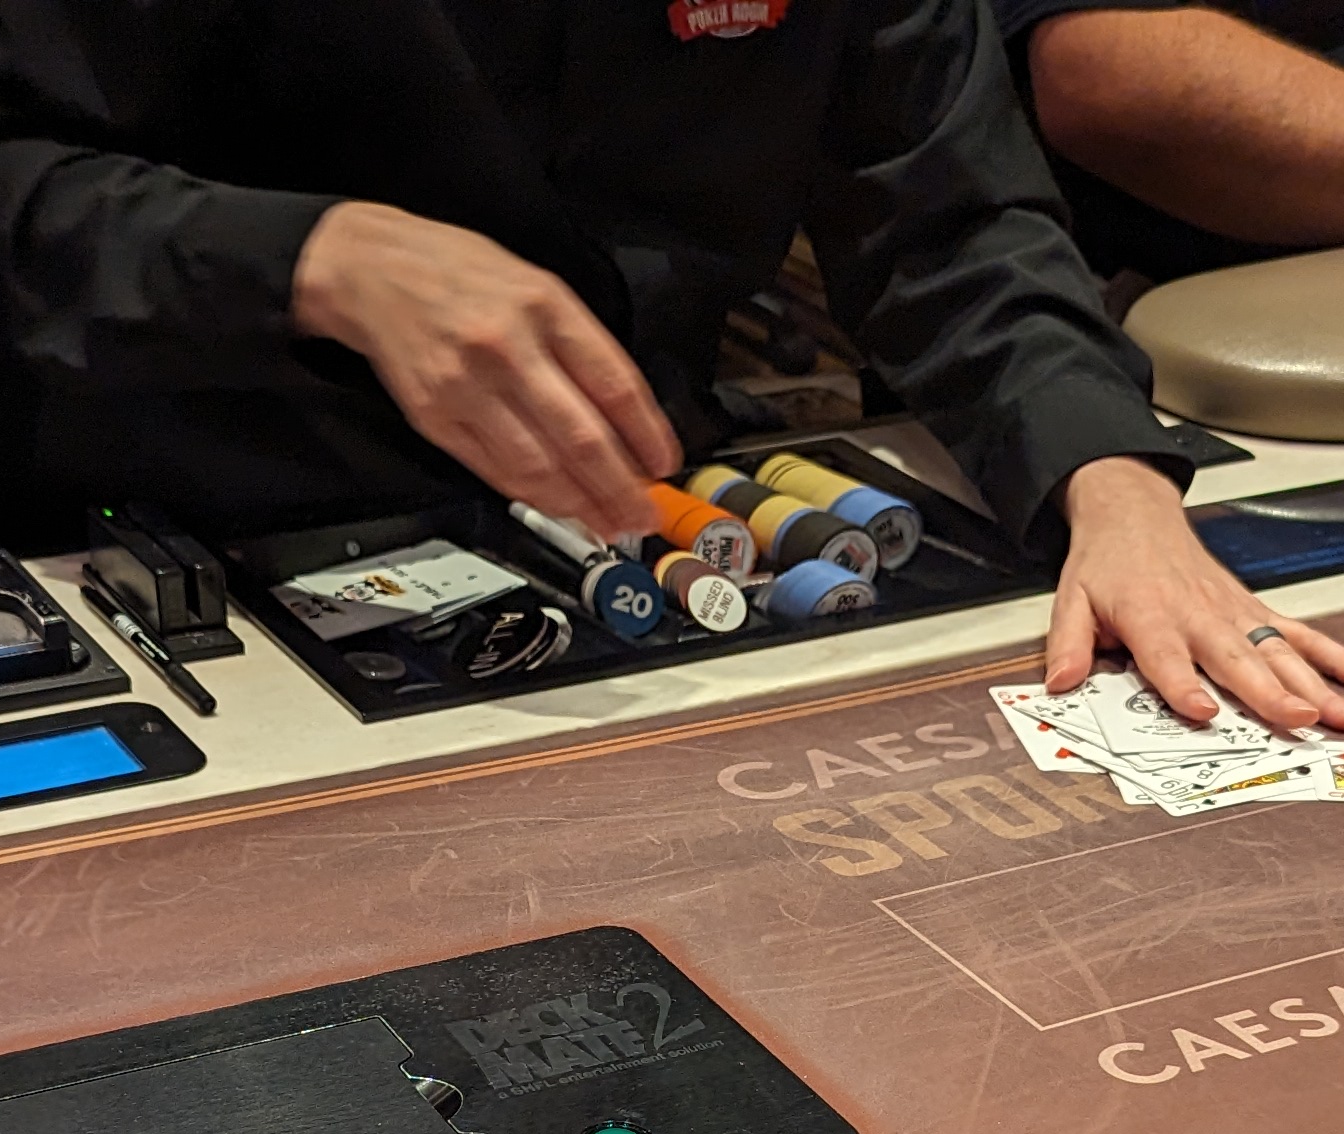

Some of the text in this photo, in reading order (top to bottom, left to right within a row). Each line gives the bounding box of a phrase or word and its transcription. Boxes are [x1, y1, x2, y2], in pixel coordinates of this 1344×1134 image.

[610, 584, 654, 620] 20
[698, 580, 725, 622] MISSED
[712, 591, 736, 625] BLIND
[1197, 769, 1213, 780] 8
[444, 992, 617, 1053] DECK
[472, 982, 706, 1091] MATE 2
[510, 1079, 557, 1097] SHFL
[558, 1052, 667, 1085] entertainment
[667, 1038, 725, 1059] solution
